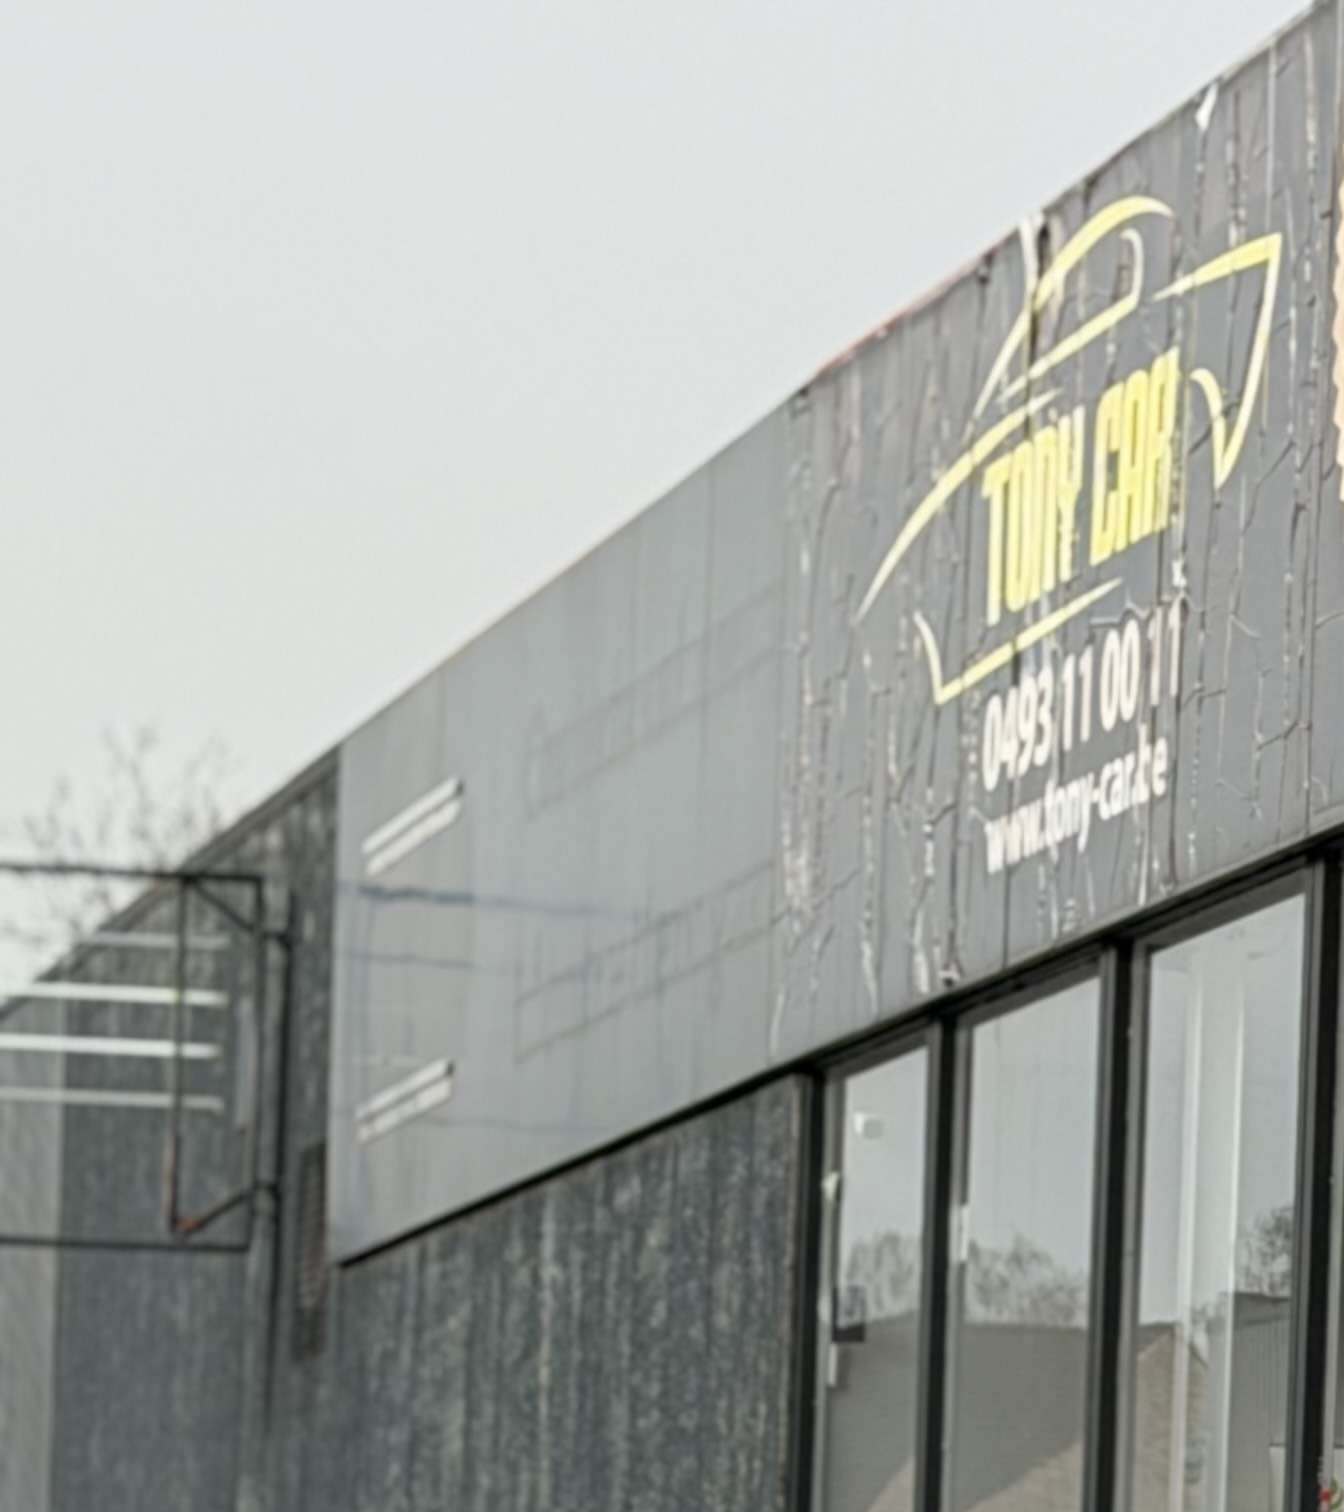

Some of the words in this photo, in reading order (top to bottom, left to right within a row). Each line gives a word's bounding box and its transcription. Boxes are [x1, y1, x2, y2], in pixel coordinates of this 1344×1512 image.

[981, 404, 1086, 627] TONY
[1089, 345, 1180, 567] CAR
[982, 665, 1056, 792] 0493
[1062, 644, 1093, 752] 11
[1100, 618, 1141, 732] 00
[1146, 602, 1182, 707] 11
